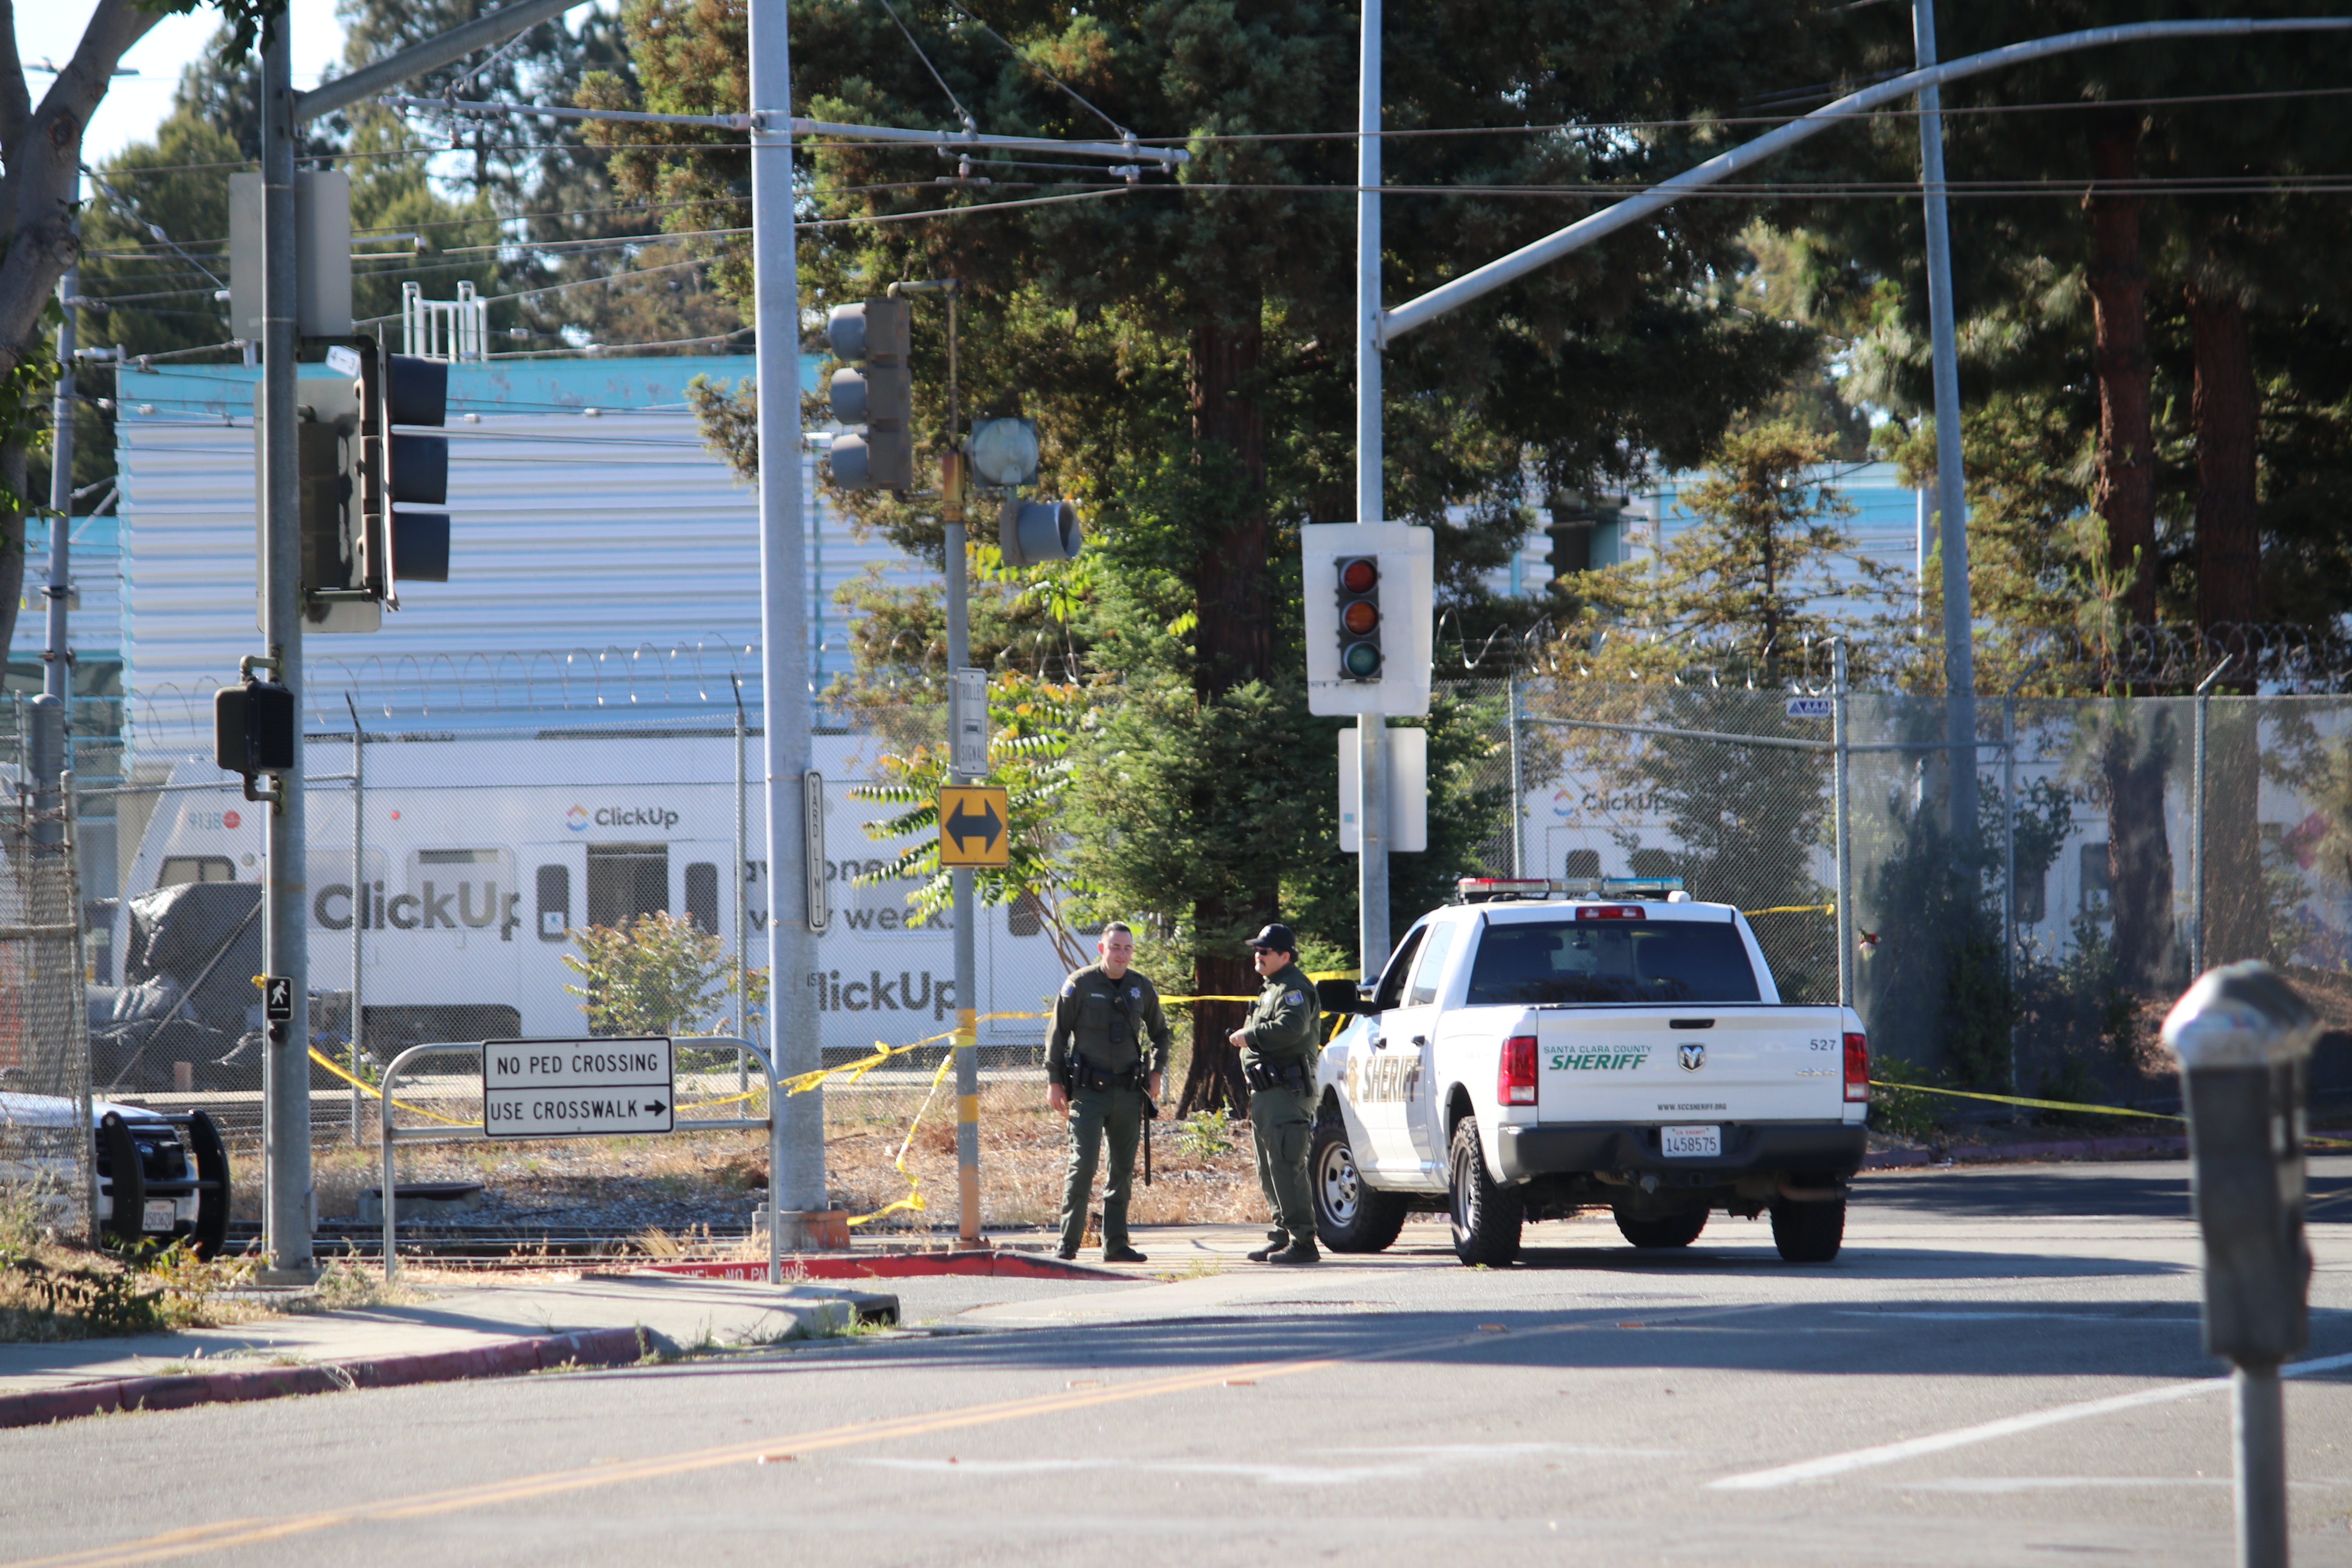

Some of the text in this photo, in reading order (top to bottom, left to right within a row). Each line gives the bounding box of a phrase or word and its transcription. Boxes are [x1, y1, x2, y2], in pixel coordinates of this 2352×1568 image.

[961, 744, 985, 762] SIGNAL
[595, 806, 679, 829] ClickUp
[811, 780, 821, 920] YARD LIMIT
[819, 969, 955, 1021] lickUp
[1810, 1039, 1837, 1051] 527
[497, 1054, 657, 1075] NO PED CROSSING
[1549, 1054, 1648, 1070] SHERIFF
[1363, 1056, 1422, 1102] SHERIFF
[490, 1100, 638, 1120] USE CROSSWALK
[1667, 1137, 1717, 1152] 1458575
